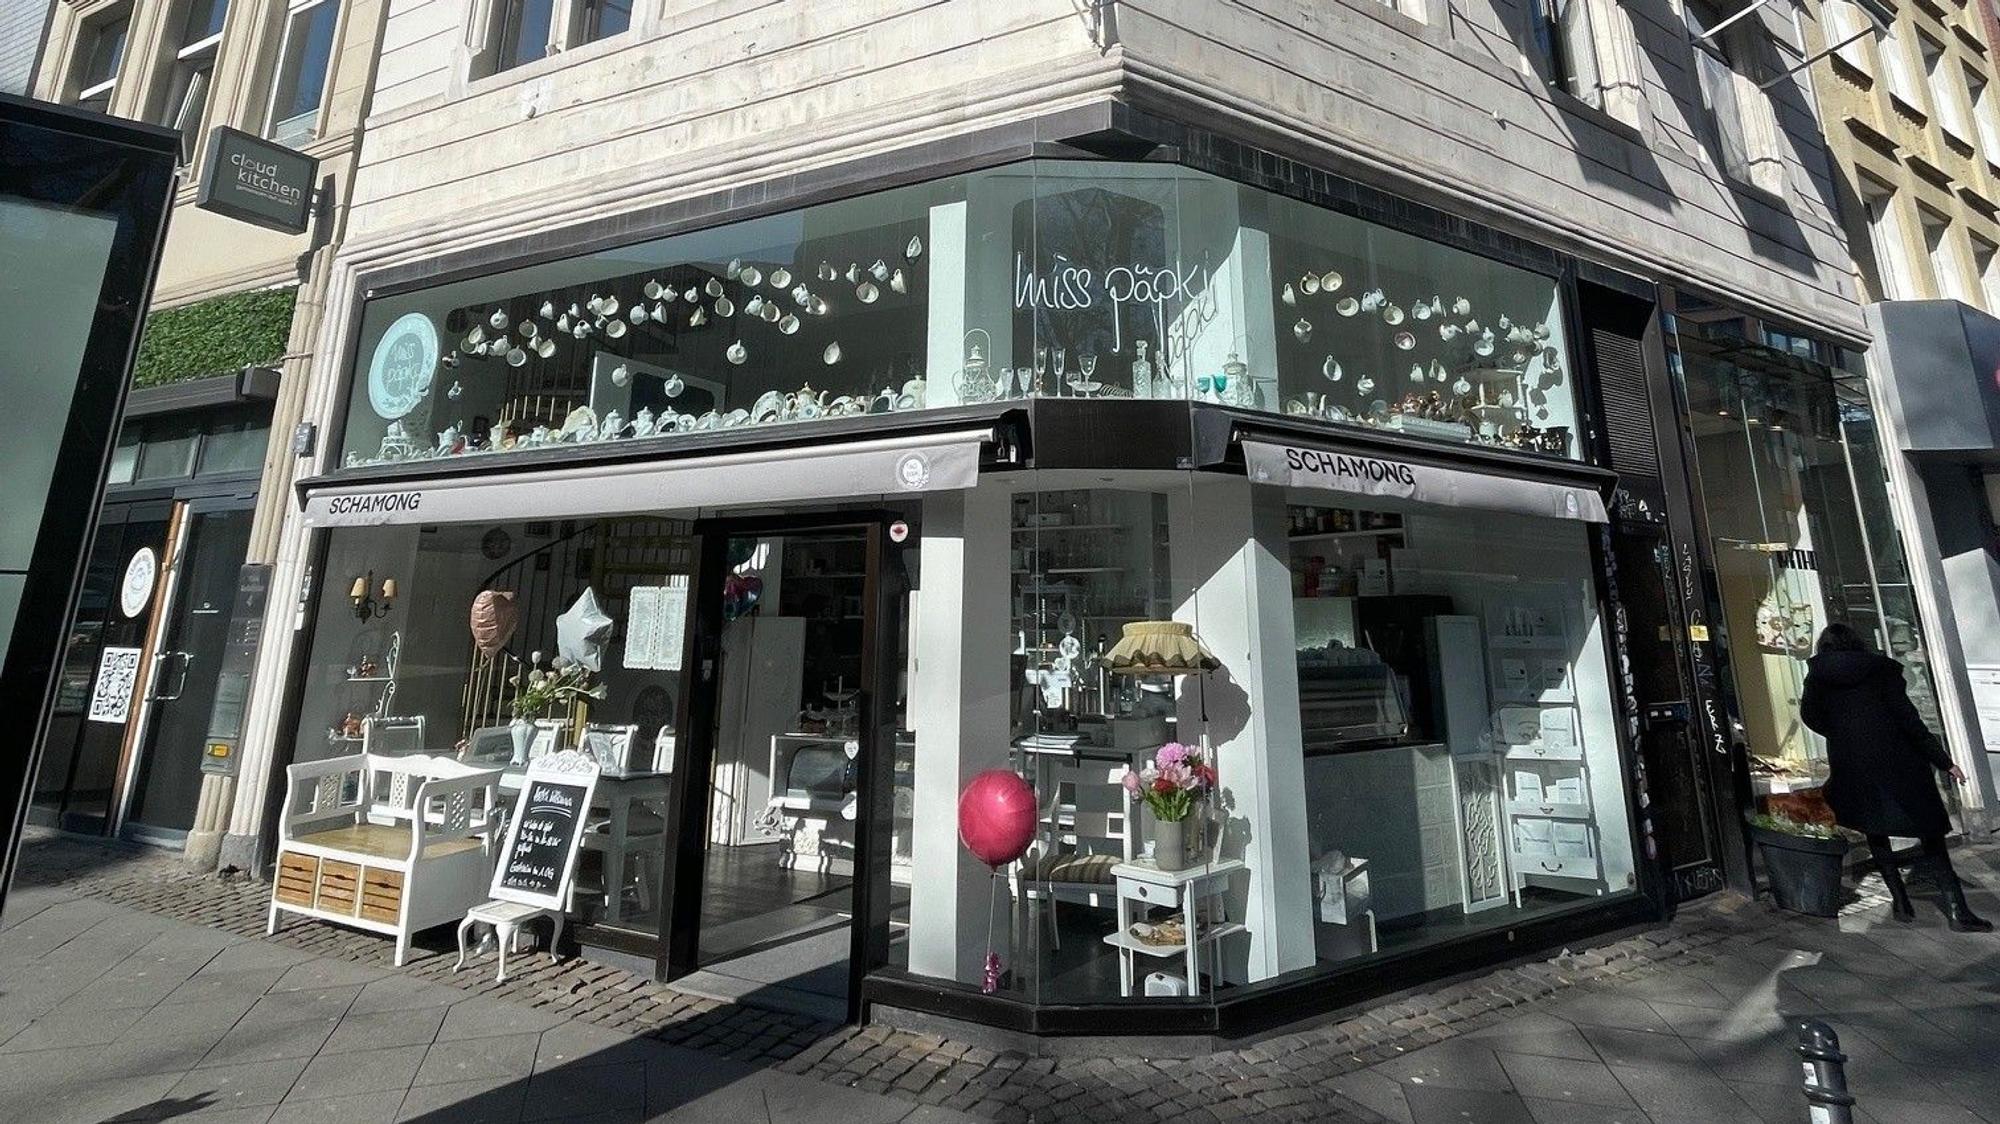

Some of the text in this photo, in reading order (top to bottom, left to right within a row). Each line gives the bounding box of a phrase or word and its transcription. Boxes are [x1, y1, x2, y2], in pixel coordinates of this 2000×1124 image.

[231, 153, 278, 177] cloud
[238, 167, 301, 199] kitchen
[1015, 251, 1092, 309] miss
[1285, 448, 1417, 486] SCHAMONG
[329, 492, 422, 514] SCHAMONG
